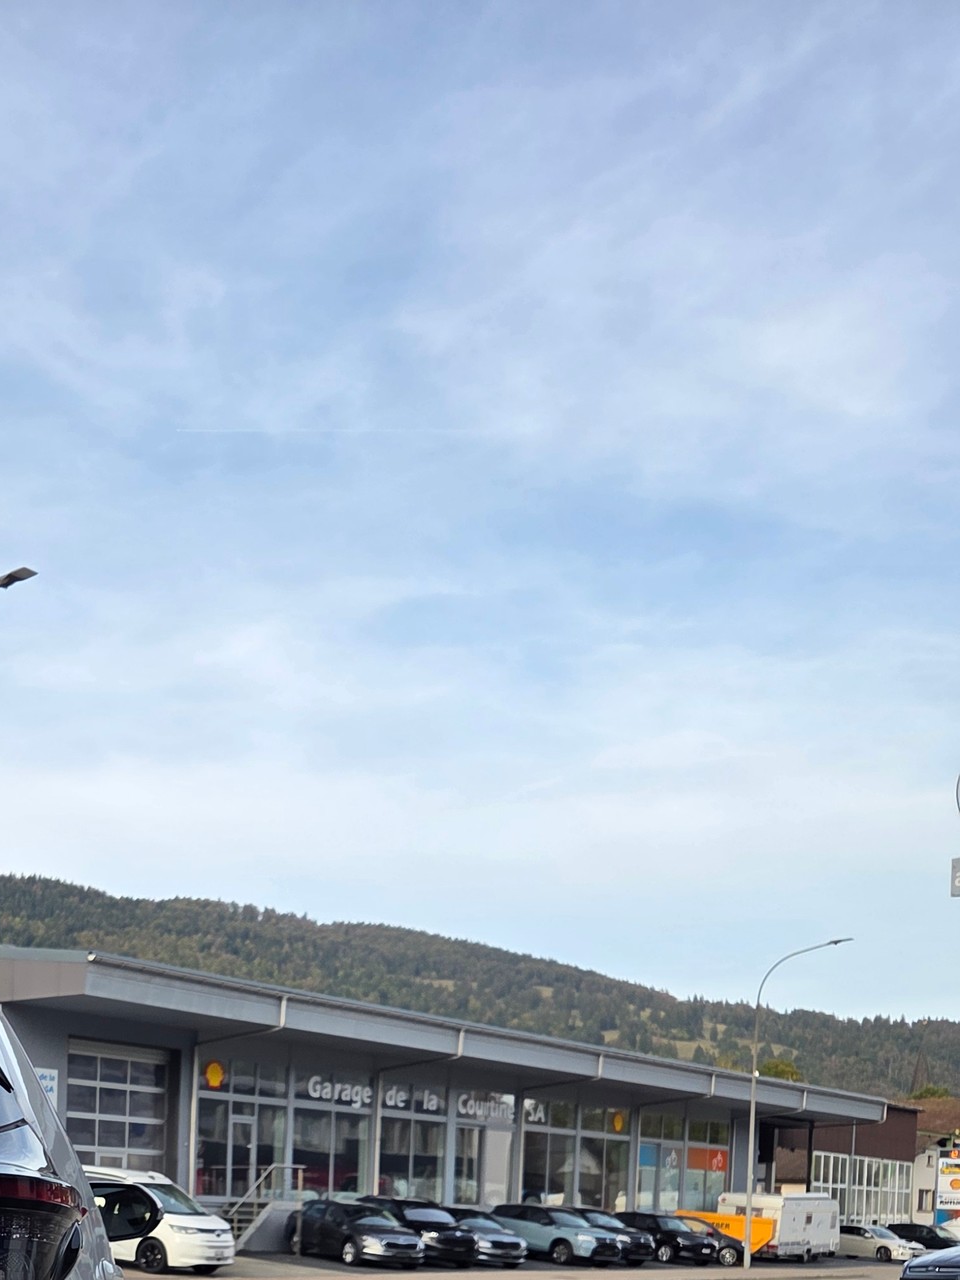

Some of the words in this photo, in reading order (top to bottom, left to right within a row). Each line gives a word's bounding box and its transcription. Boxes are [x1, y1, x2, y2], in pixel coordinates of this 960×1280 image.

[308, 1075, 373, 1109] Garage
[385, 1085, 408, 1108] de
[423, 1089, 439, 1111] la
[458, 1093, 515, 1120] Courtine
[527, 1099, 546, 1122] SA
